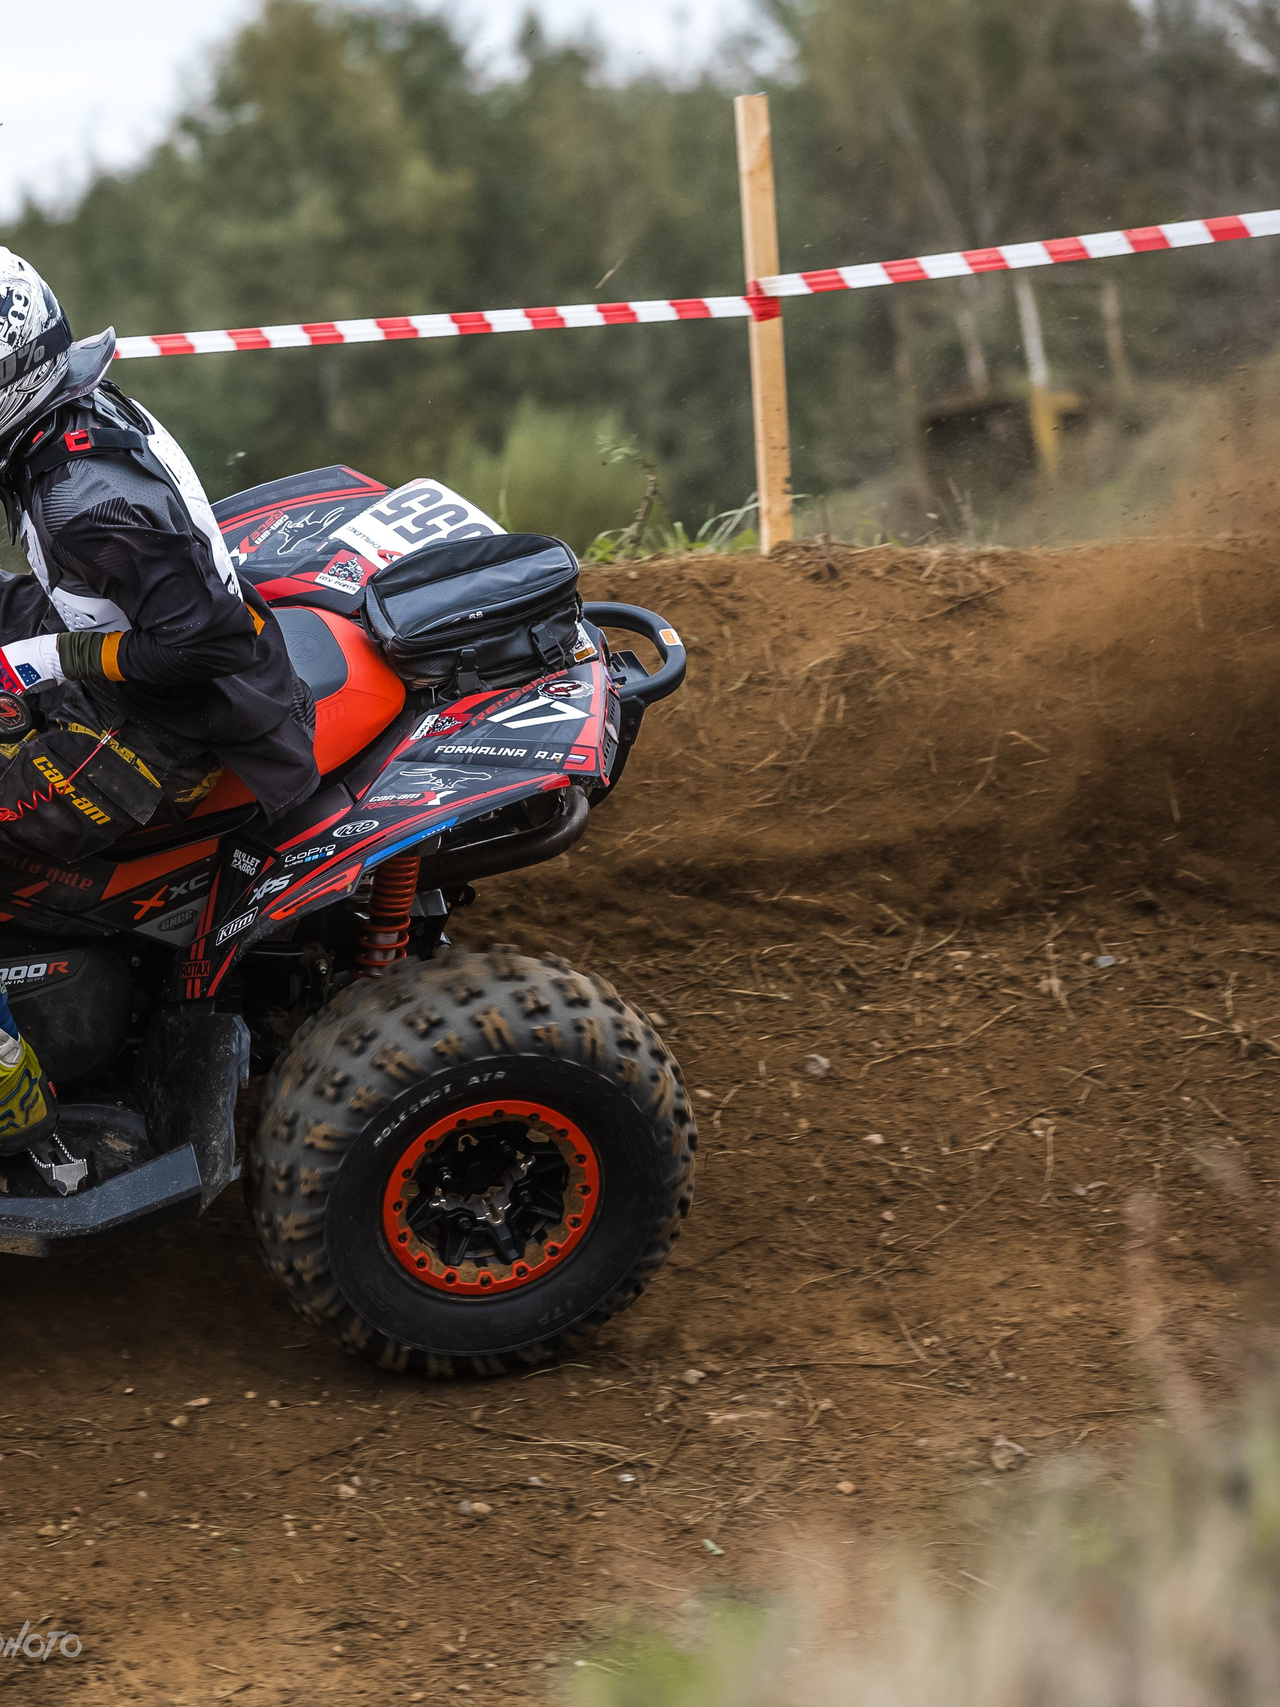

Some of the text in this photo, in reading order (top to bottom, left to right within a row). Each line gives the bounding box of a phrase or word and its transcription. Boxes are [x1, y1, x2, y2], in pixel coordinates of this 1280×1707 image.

[470, 669, 569, 726] RENEGADE
[434, 744, 528, 758] FORMALINA
[32, 755, 116, 827] can-am
[369, 792, 422, 804] can-am
[233, 848, 261, 868] BULLET
[284, 843, 337, 864] GoPro
[181, 961, 211, 978] ROTAX
[4, 978, 25, 986] WIN
[372, 1070, 507, 1148] HOLESHOT ATR
